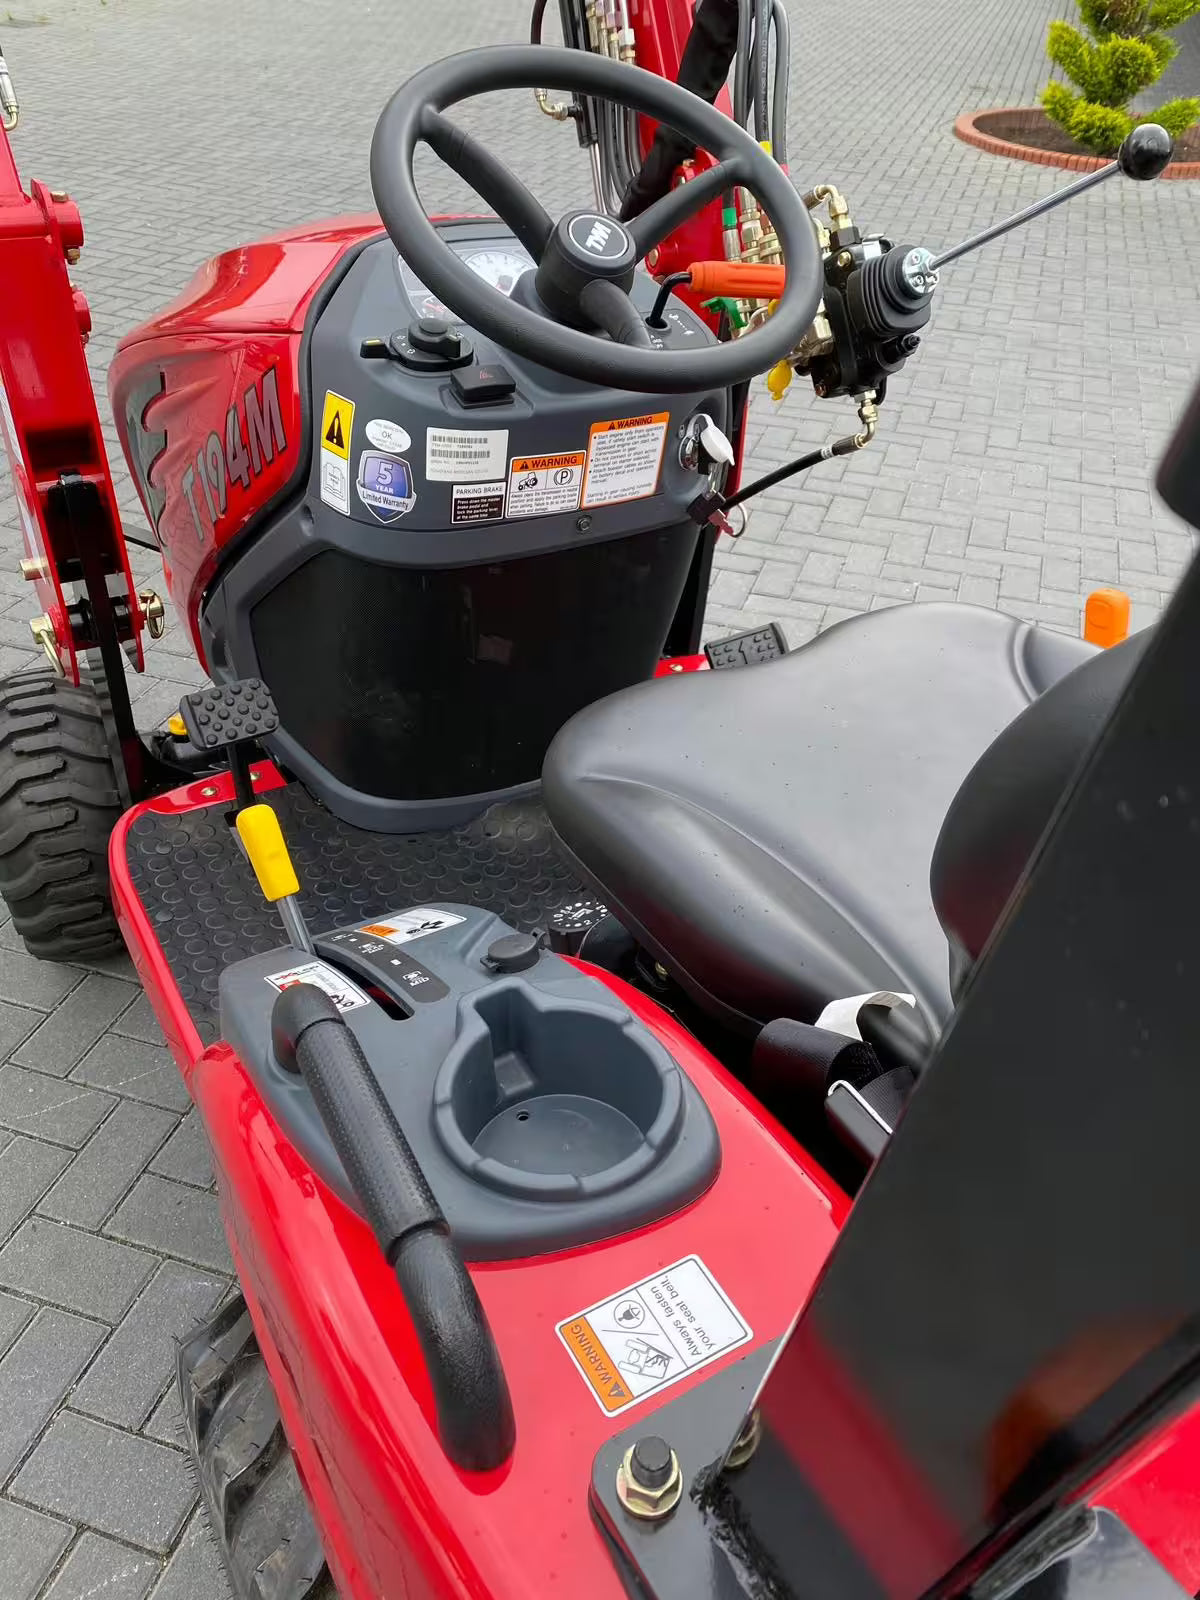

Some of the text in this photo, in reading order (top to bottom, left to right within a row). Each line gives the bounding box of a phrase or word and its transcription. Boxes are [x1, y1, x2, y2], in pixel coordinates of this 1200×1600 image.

[618, 416, 652, 429] WARNING
[382, 431, 392, 439] OK
[182, 366, 287, 542] T194M
[531, 456, 577, 468] WARNING
[376, 461, 393, 485] 5
[375, 485, 394, 494] YEAR
[362, 491, 409, 510] Limited Warranty
[650, 1286, 703, 1357] Always fasten
[660, 1275, 718, 1351] your seat belt.
[570, 1324, 612, 1385] WARNING
